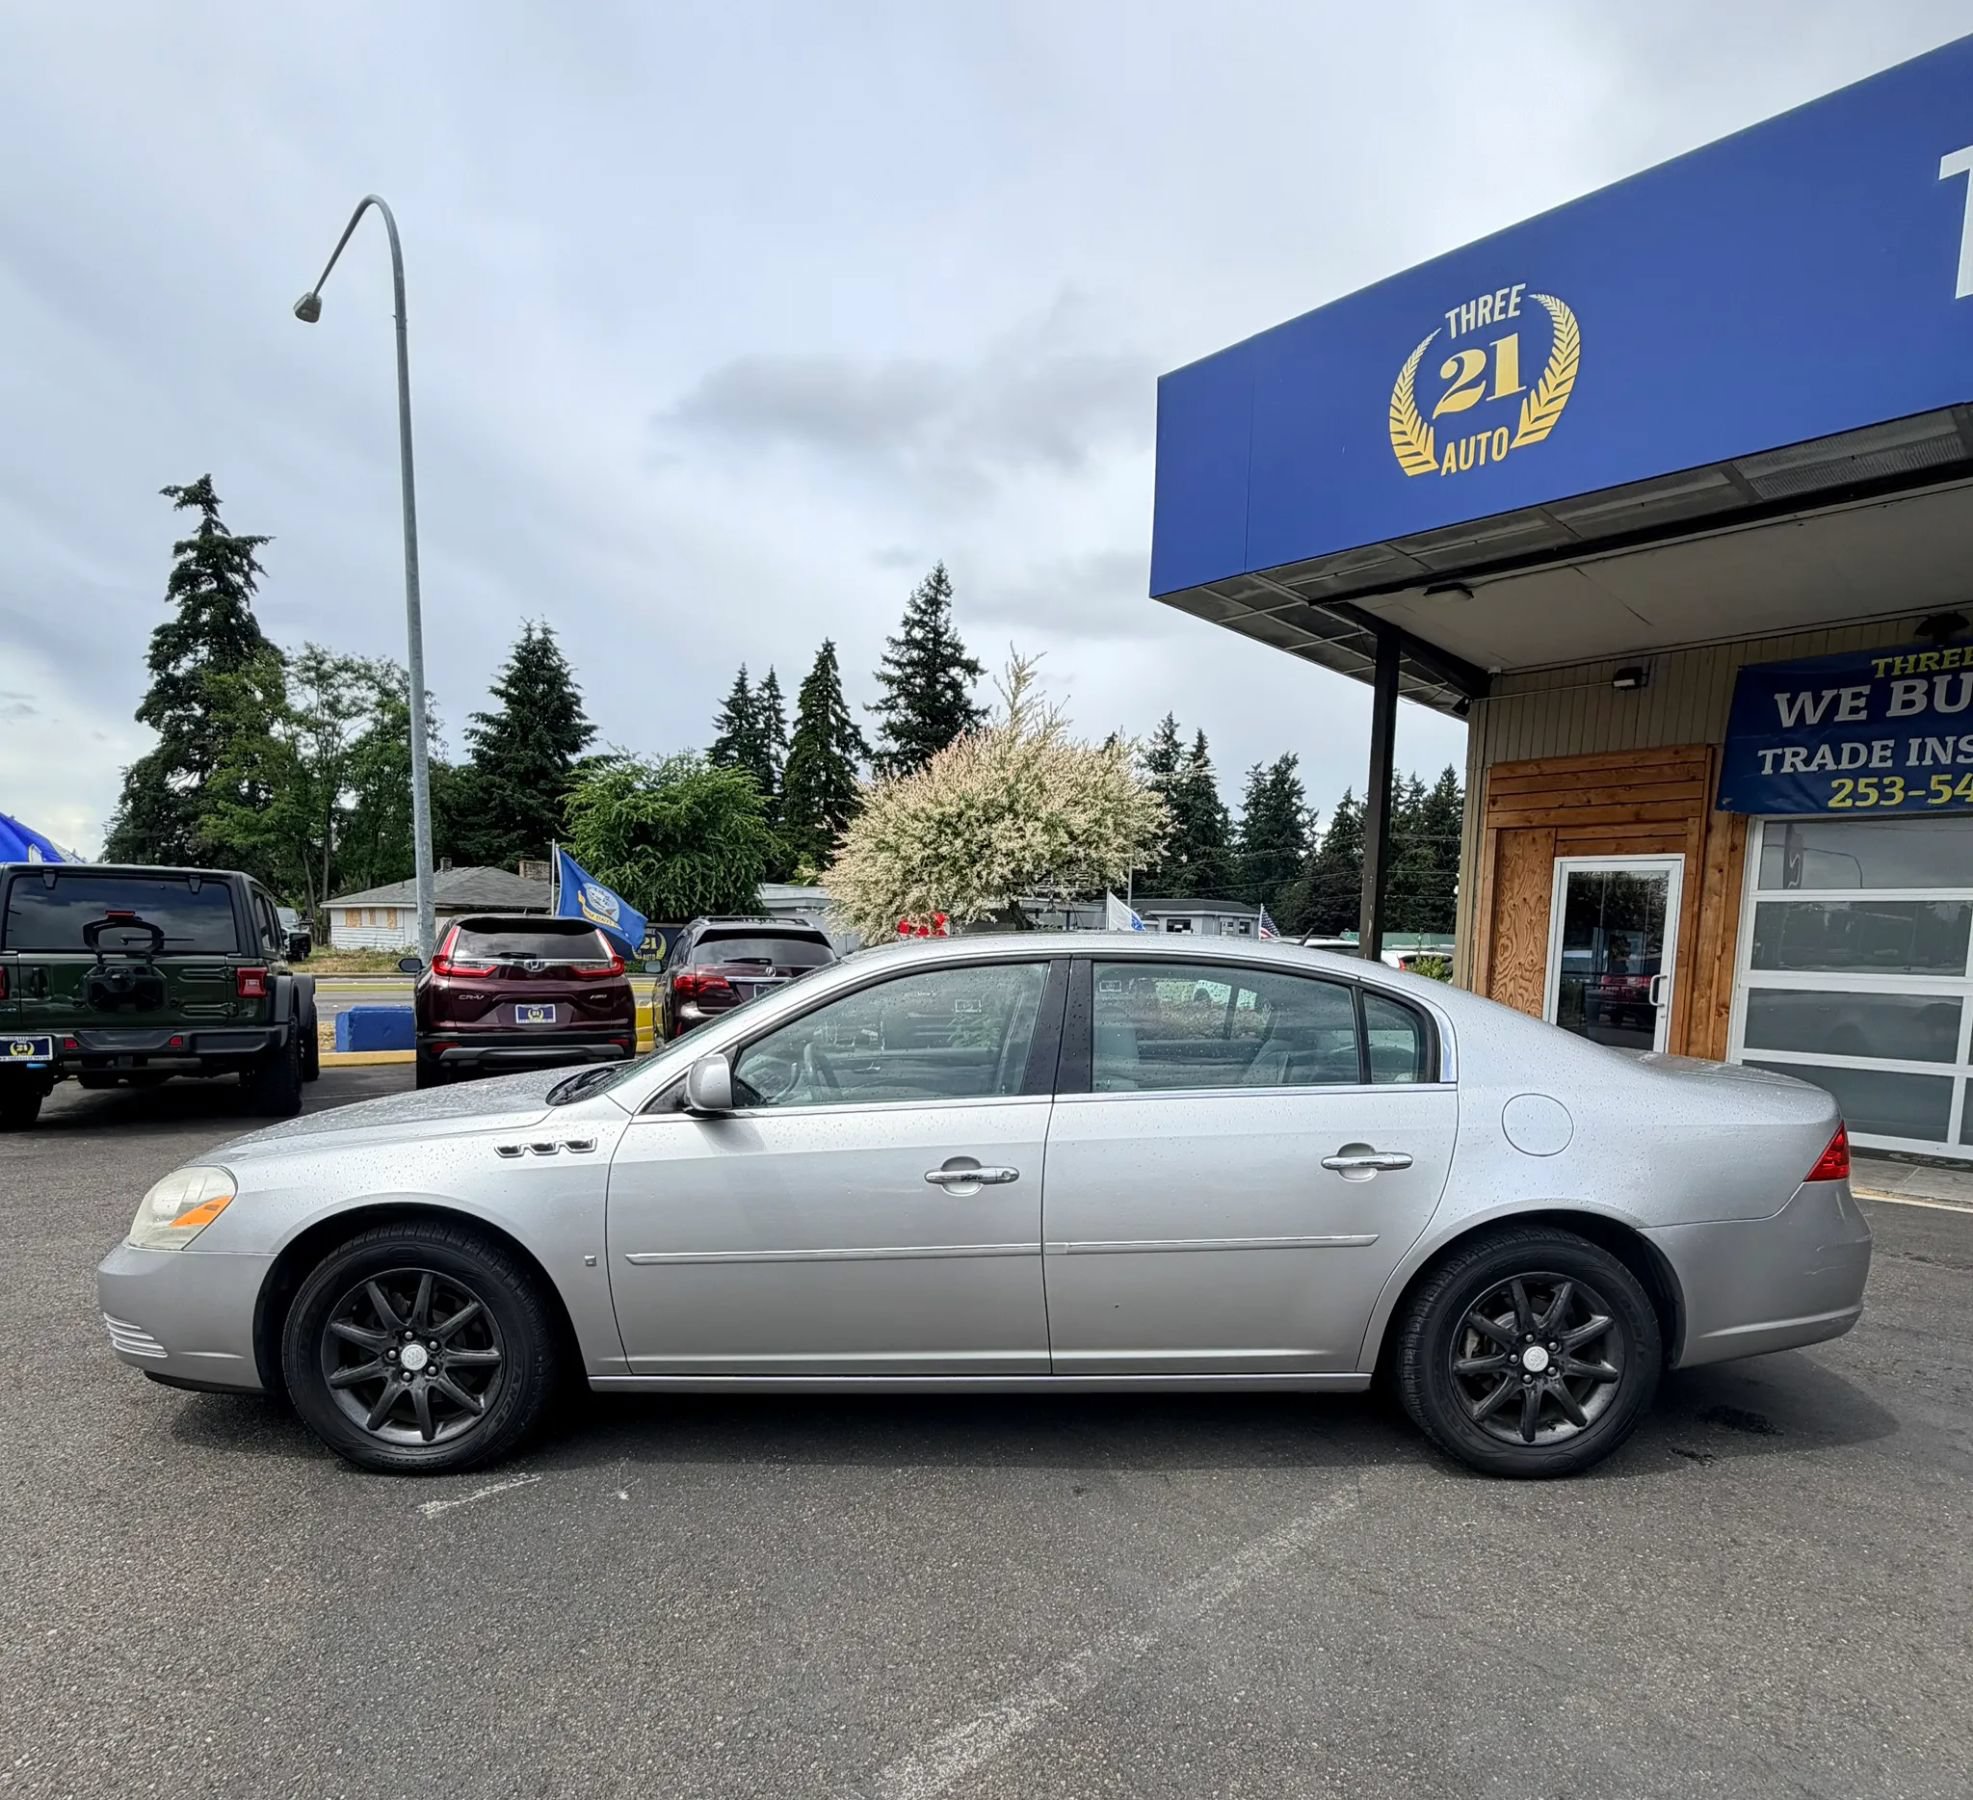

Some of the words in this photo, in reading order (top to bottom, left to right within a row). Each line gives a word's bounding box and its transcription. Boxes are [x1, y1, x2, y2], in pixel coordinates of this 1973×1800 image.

[1445, 283, 1526, 339] THREE
[1432, 332, 1527, 420] 21
[1440, 426, 1510, 476] AUTO
[1773, 685, 1871, 728] WE
[1757, 740, 1895, 775] TRADE
